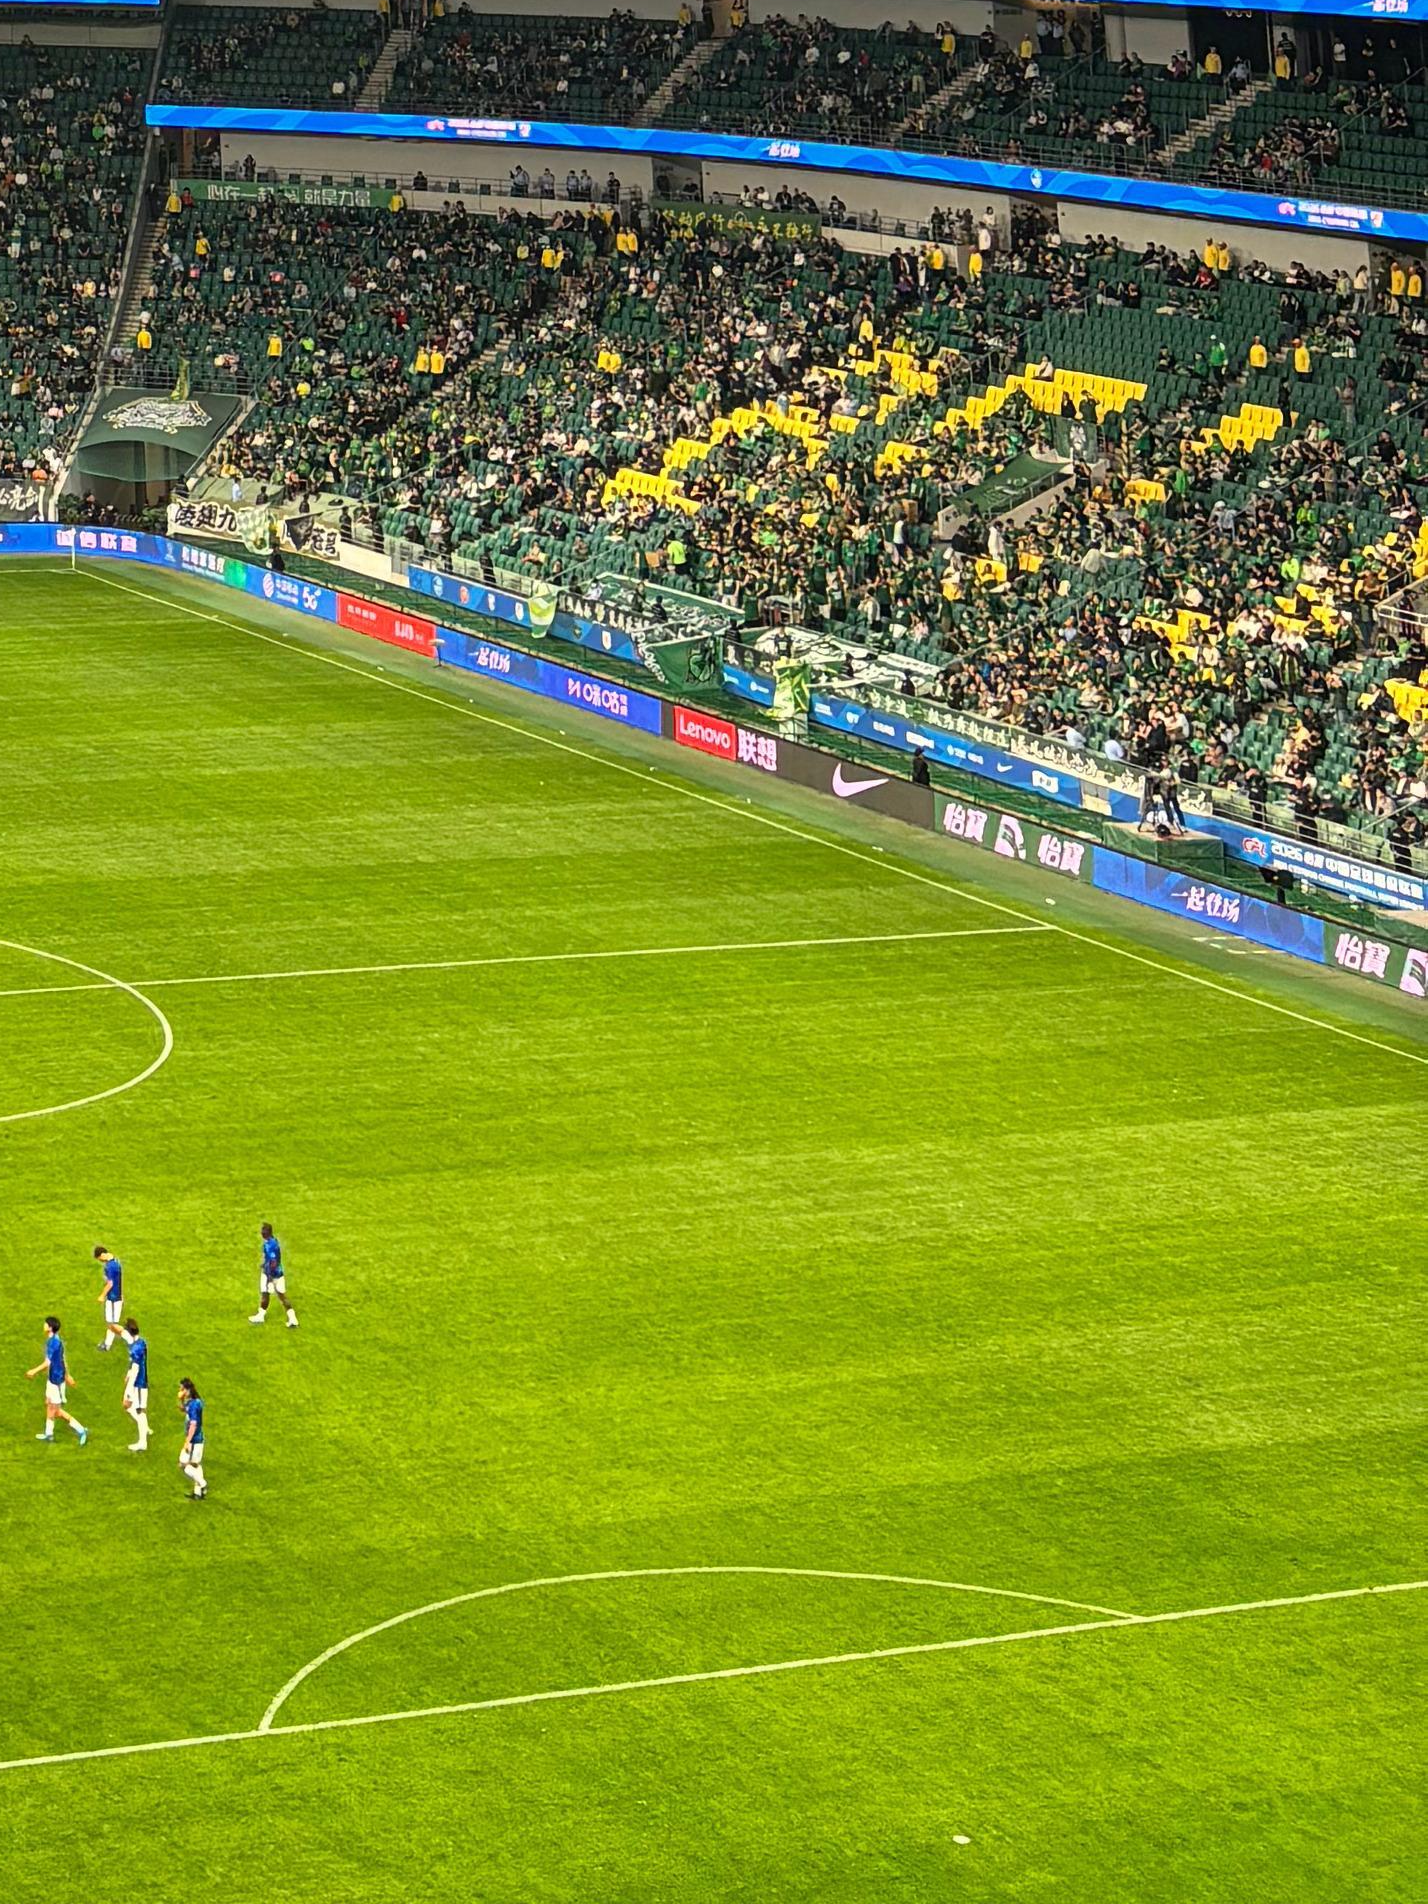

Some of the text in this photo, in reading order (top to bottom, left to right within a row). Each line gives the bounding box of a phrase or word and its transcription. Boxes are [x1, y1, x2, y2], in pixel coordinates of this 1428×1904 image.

[679, 714, 777, 772] Lenovo 联想
[1271, 840, 1303, 863] 2026
